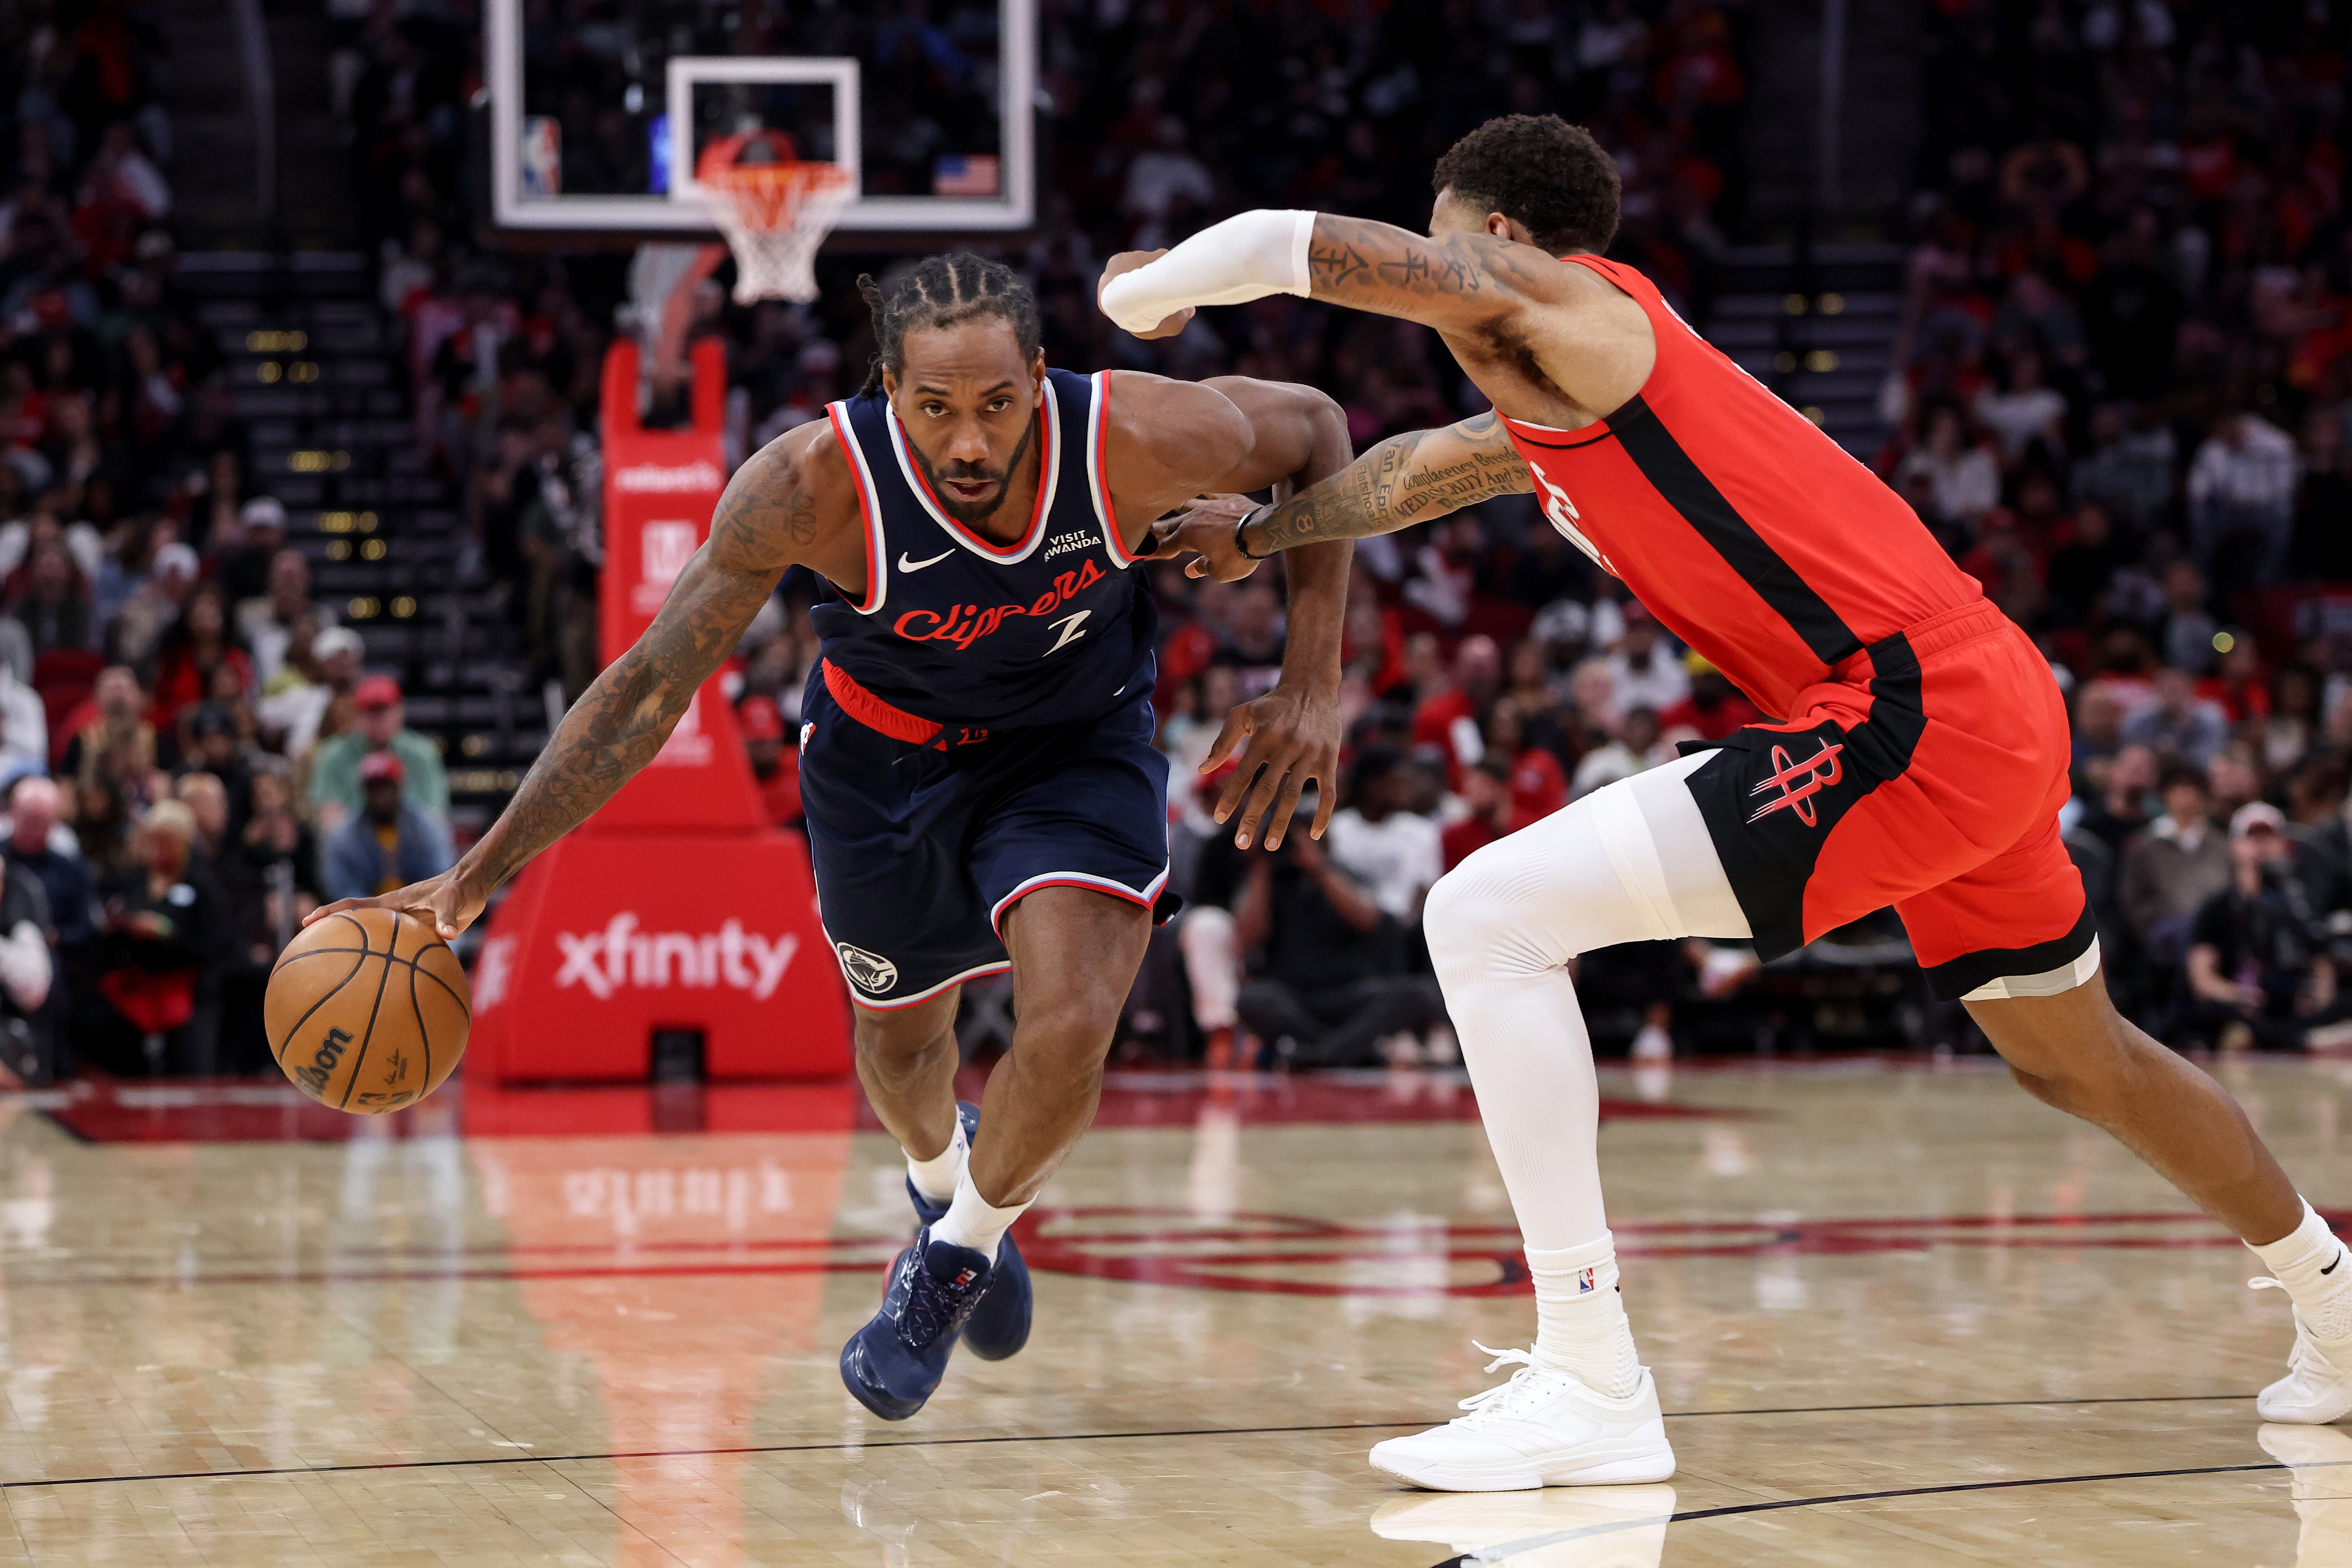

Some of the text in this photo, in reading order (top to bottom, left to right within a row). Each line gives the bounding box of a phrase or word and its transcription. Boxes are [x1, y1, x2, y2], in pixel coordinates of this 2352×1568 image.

[1404, 461, 1479, 490] Complacency
[1485, 467, 1513, 485] And
[1044, 536, 1102, 562] RWANDA
[1049, 530, 1085, 545] VISIT
[893, 559, 1107, 651] Clippers
[555, 911, 798, 1000] xfinity
